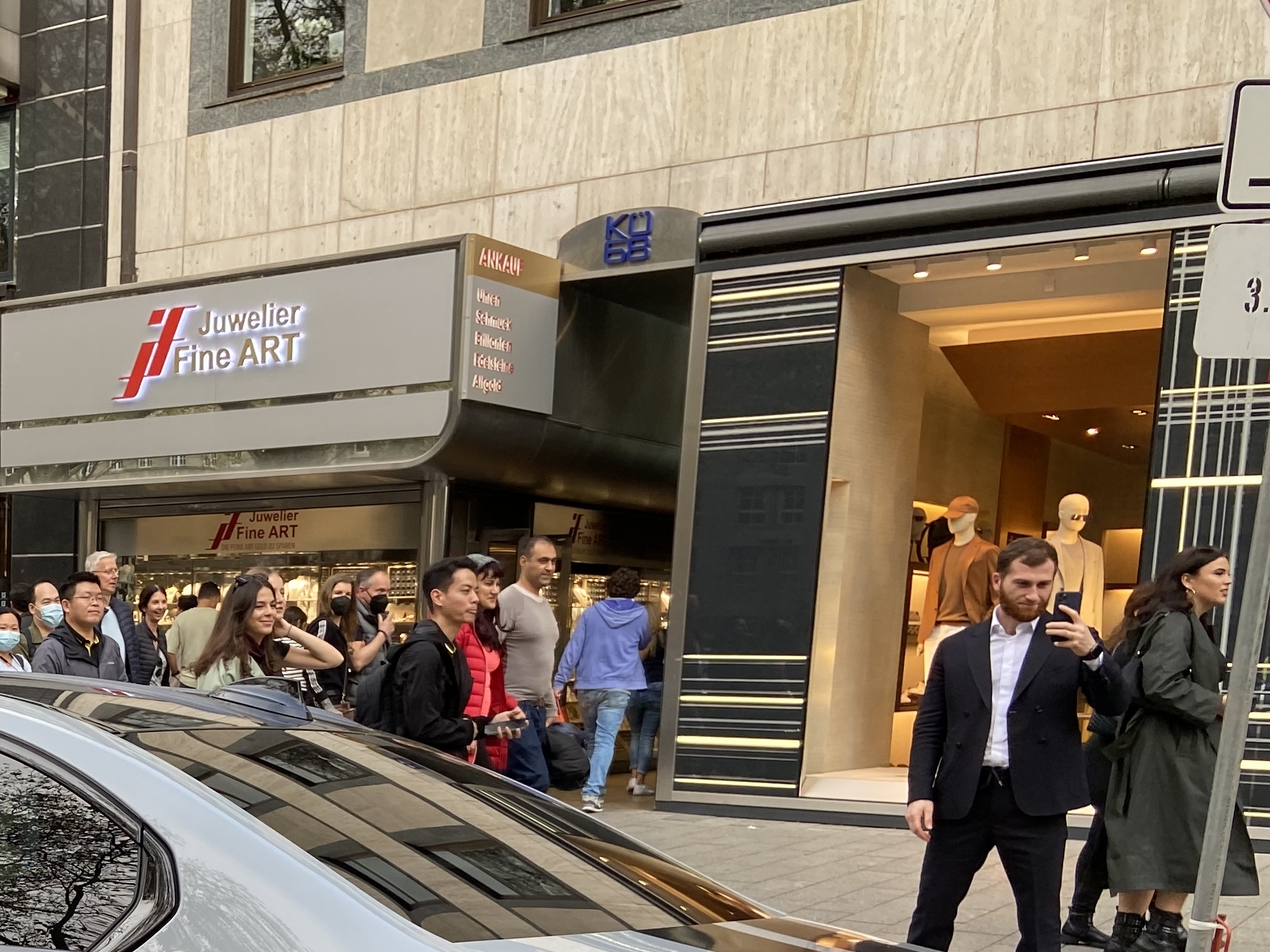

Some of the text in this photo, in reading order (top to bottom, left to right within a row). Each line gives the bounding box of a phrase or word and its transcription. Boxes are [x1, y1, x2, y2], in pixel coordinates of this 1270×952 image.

[479, 247, 523, 276] ANKAUF
[477, 287, 501, 307] Uhren
[198, 303, 301, 335] Juwelier
[475, 309, 512, 331] Schmuck
[173, 332, 301, 374] Fine ART
[249, 510, 299, 522] Juwelier
[236, 525, 298, 539] Fine ART
